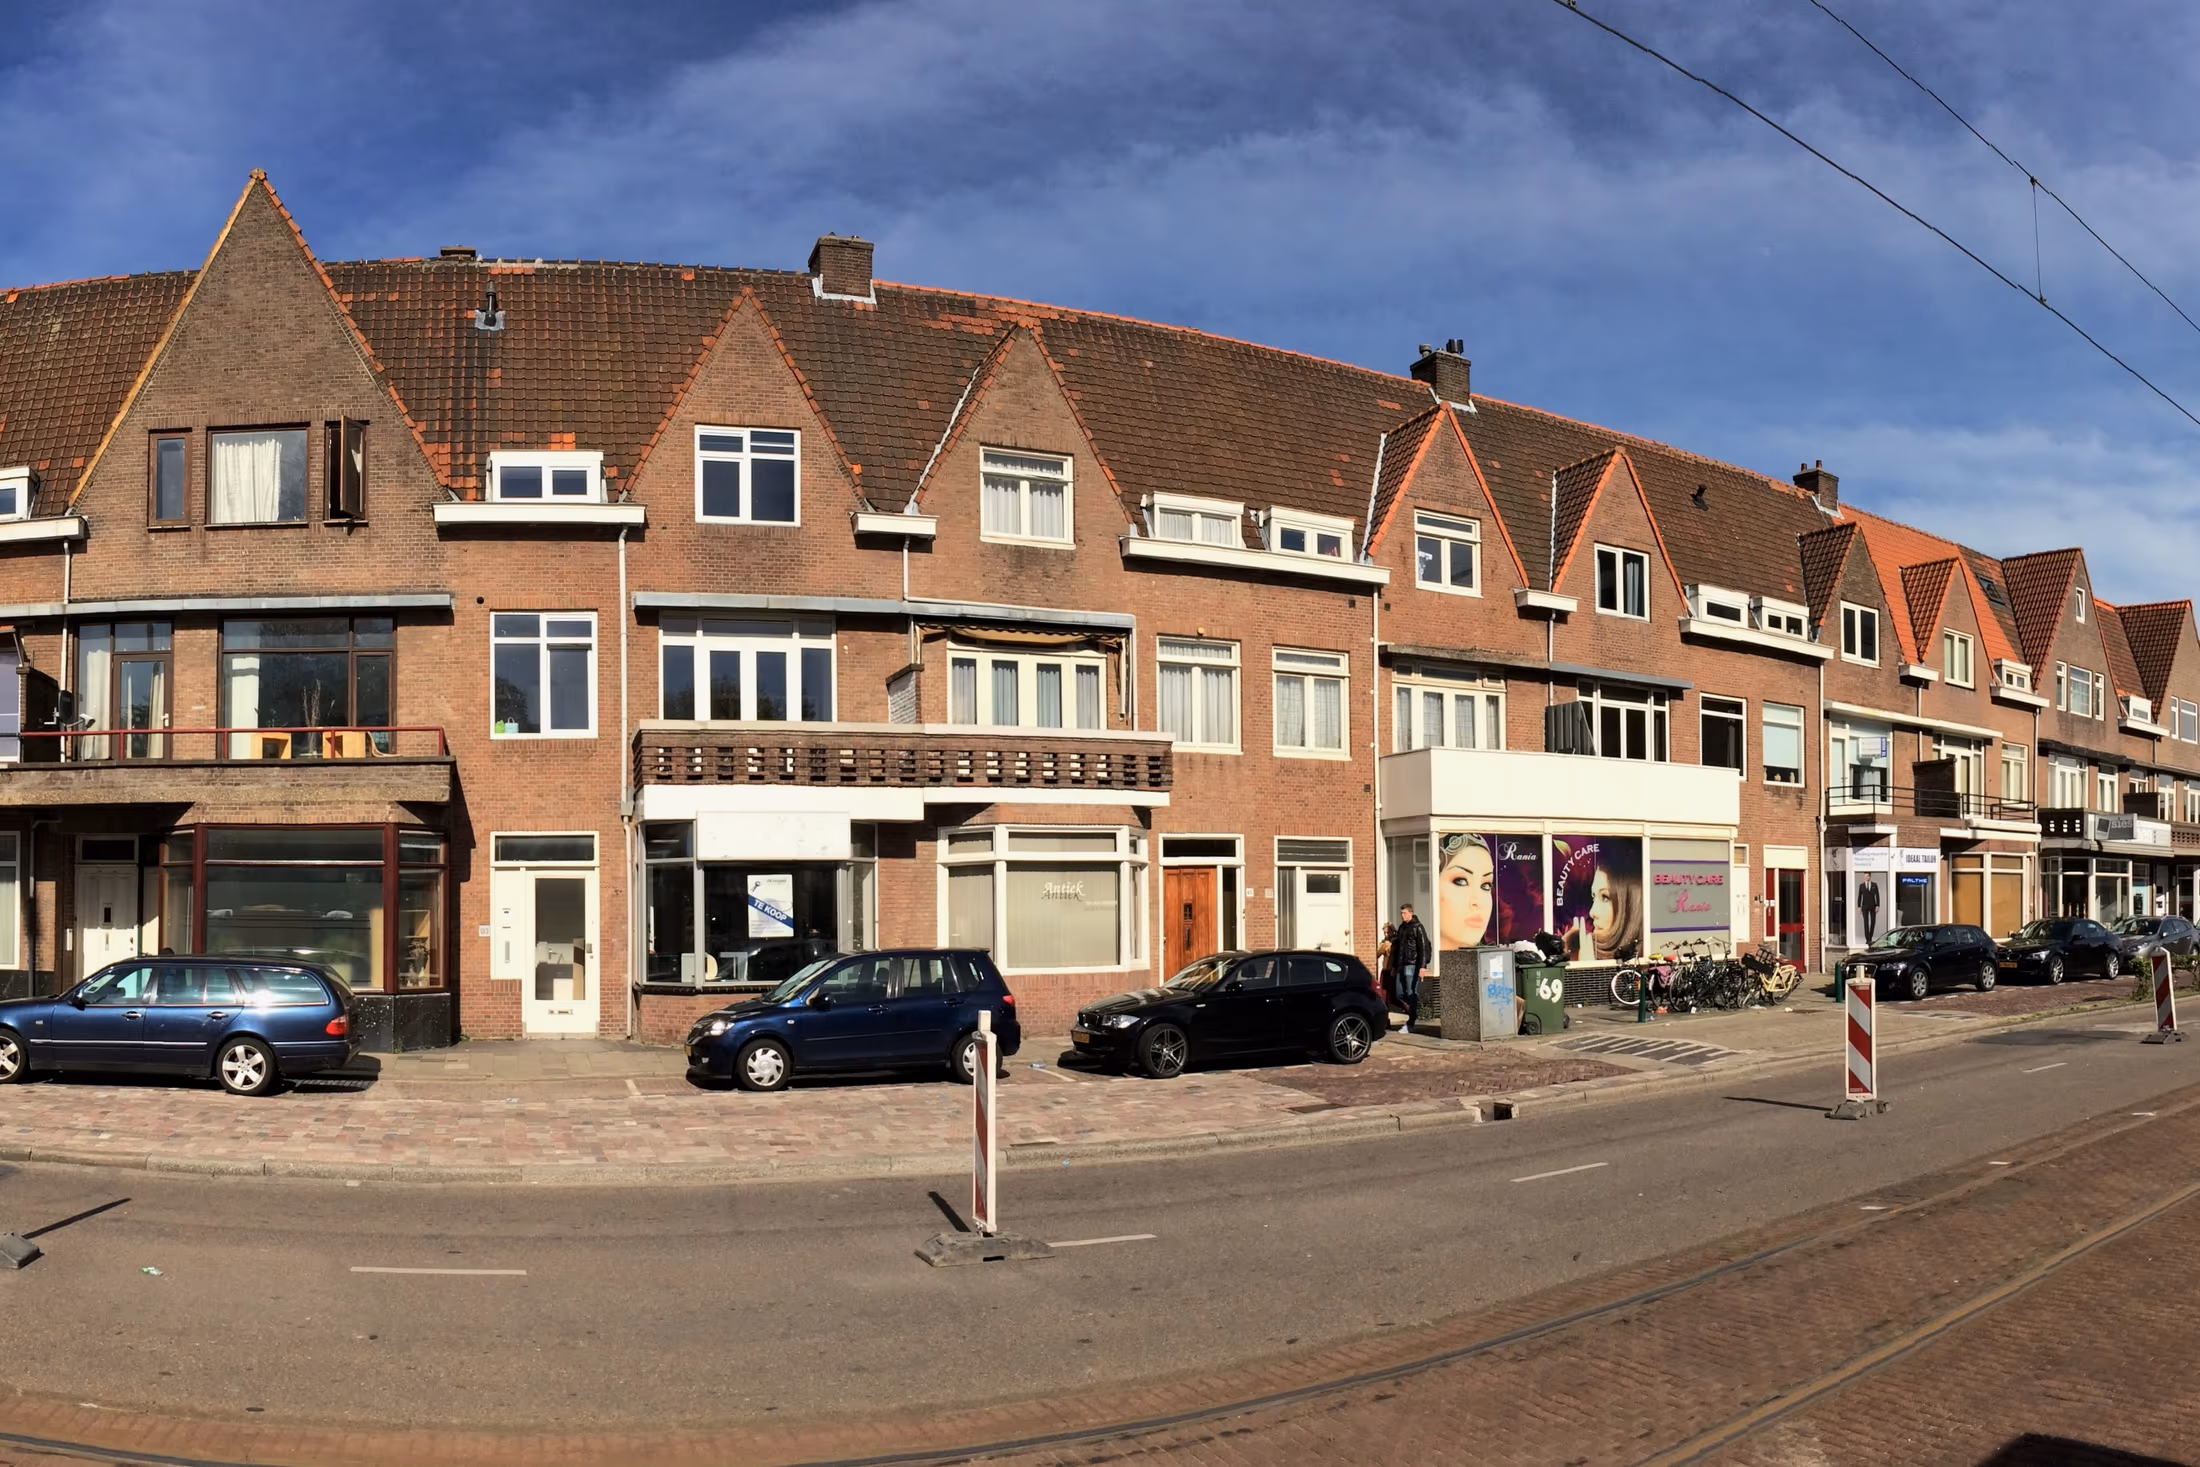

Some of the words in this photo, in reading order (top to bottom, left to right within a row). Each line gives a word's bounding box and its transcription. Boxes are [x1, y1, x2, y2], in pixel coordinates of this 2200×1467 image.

[1498, 841, 1538, 861] Rania
[1556, 857, 1575, 906] BEAUTY
[1574, 844, 1600, 860] CARE
[1654, 873, 1695, 885] BEAUTY
[1696, 873, 1724, 885] CARE
[1042, 880, 1086, 896] Antiek
[753, 899, 765, 910] TE
[763, 905, 787, 921] KOOP
[1540, 977, 1563, 1003] 69
